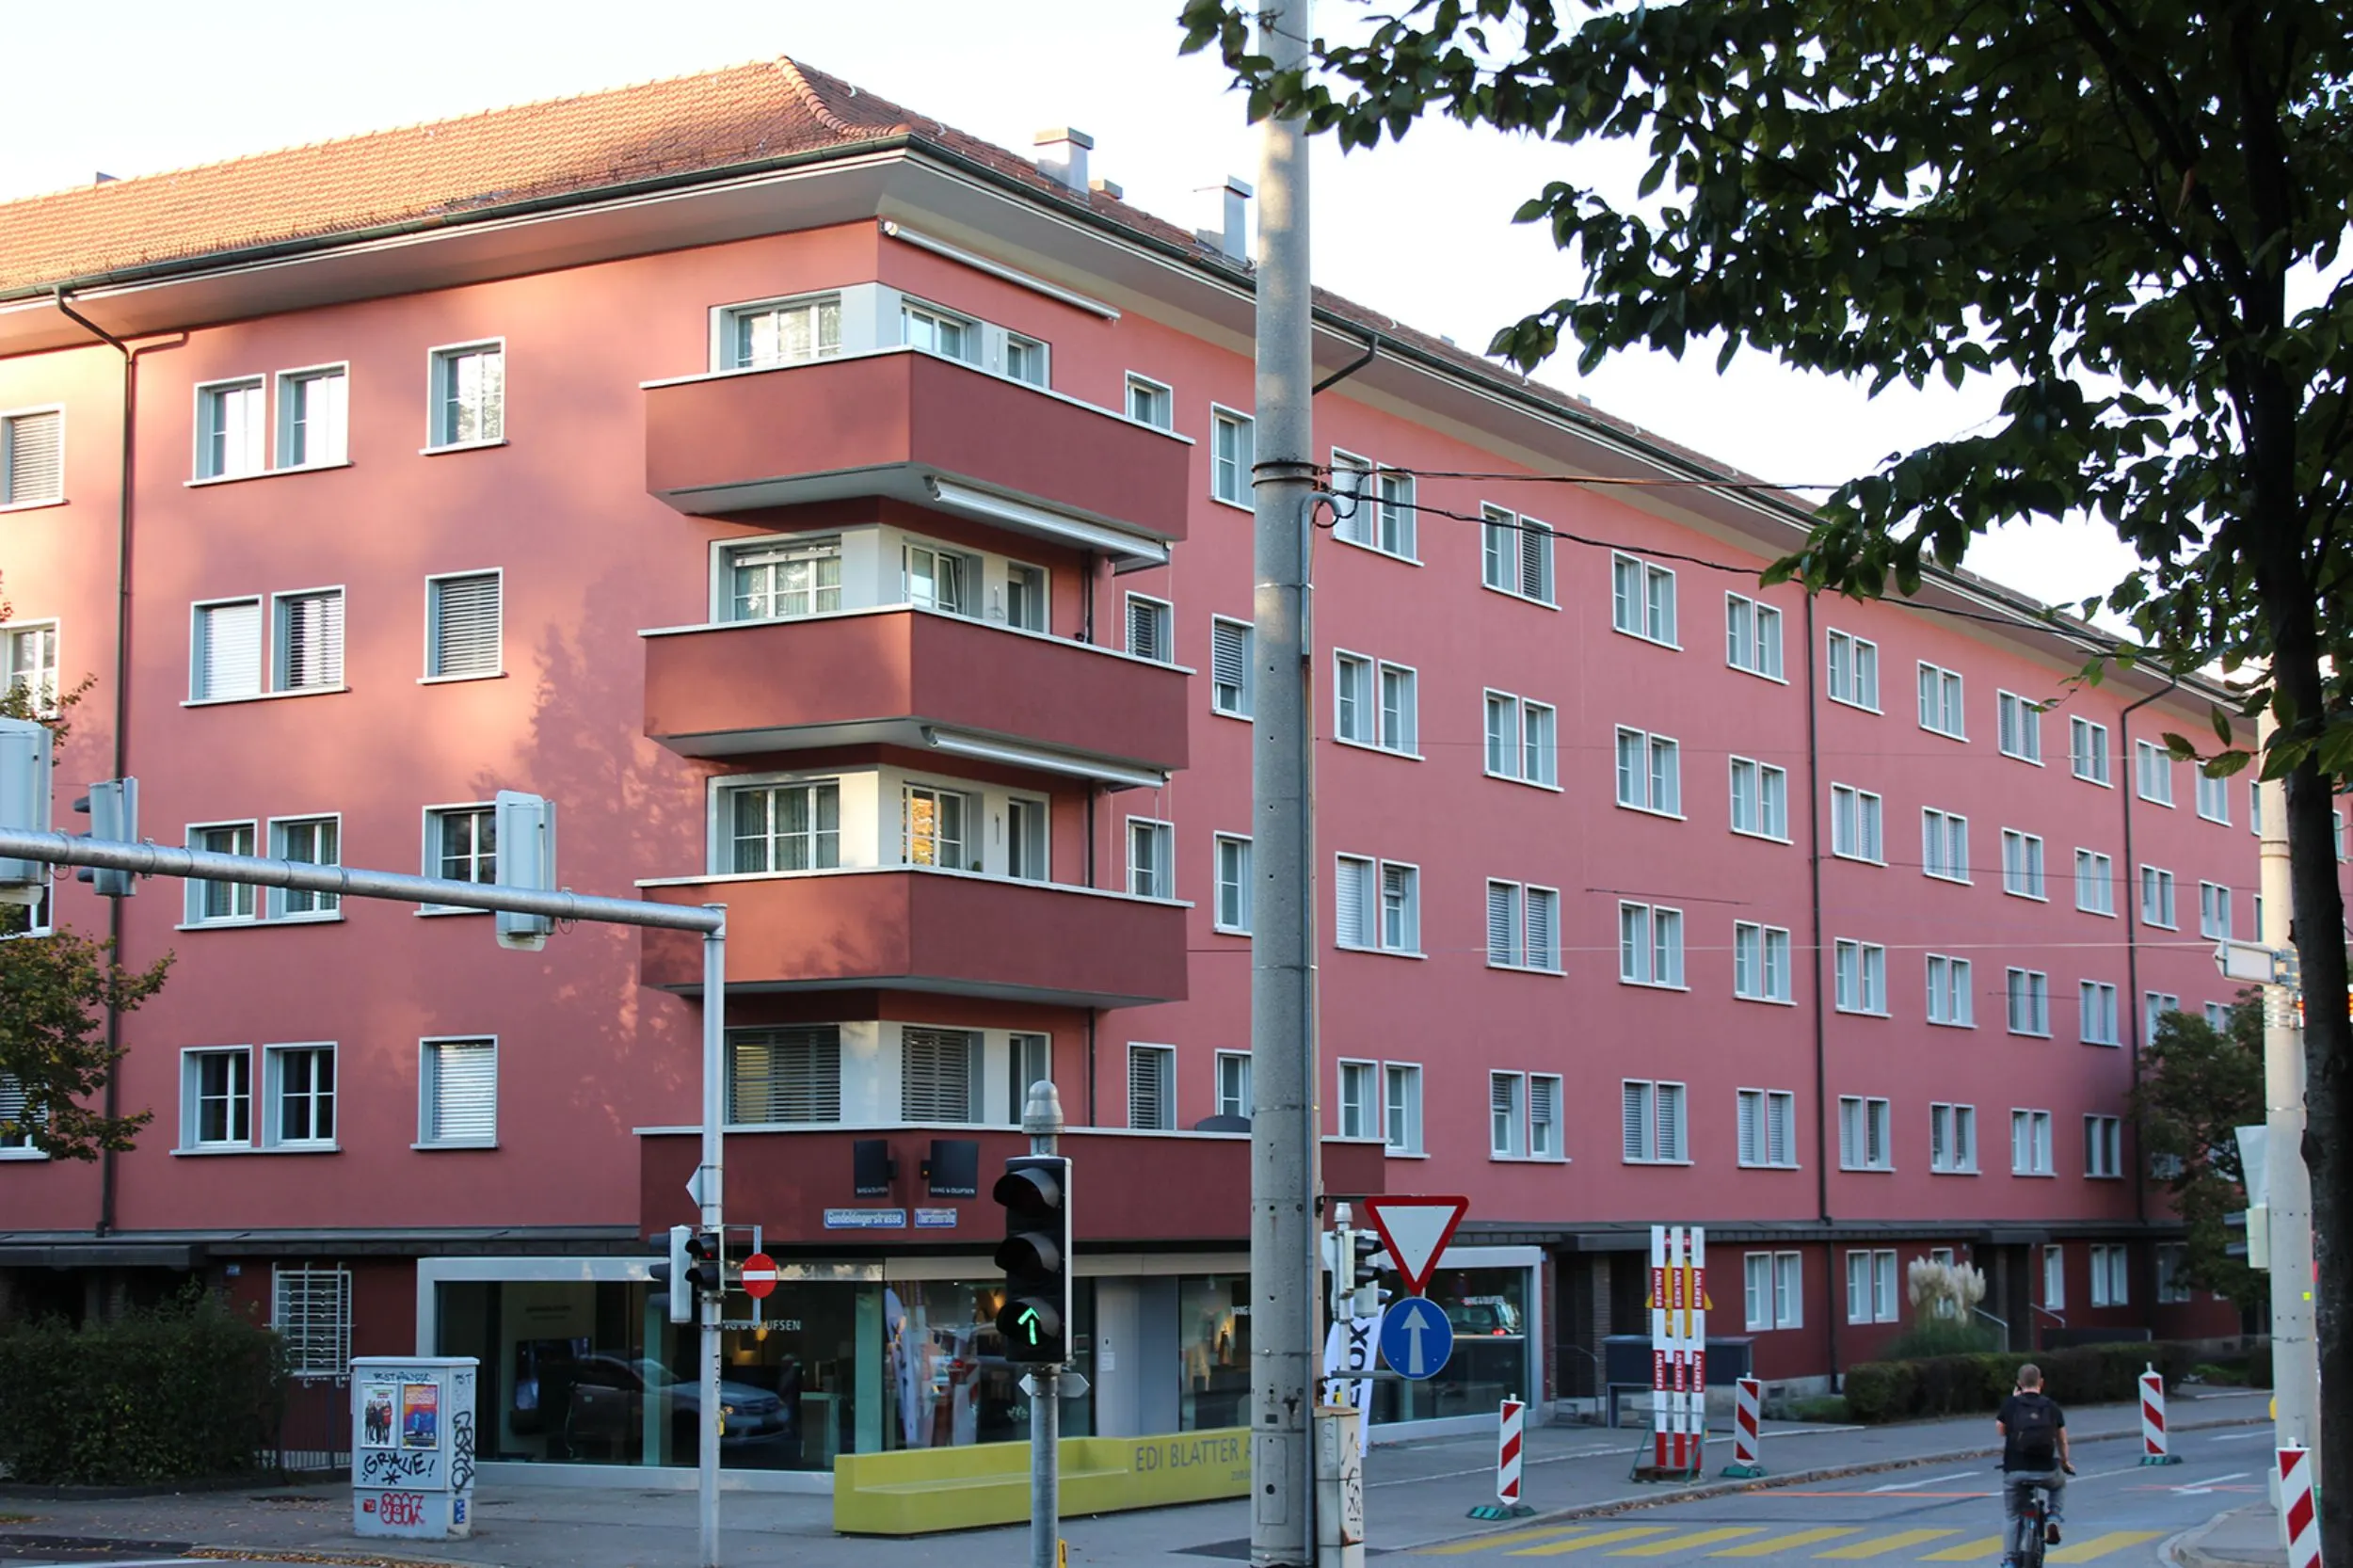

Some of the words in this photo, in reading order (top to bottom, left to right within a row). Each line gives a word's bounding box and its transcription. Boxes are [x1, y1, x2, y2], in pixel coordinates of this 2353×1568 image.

[1673, 1270, 1682, 1307] ANLIKER
[1694, 1270, 1703, 1308] ANLIKER
[1694, 1352, 1703, 1392] ANLIKER
[1135, 1445, 1163, 1472] EDI
[1171, 1437, 1239, 1468] BLATTER
